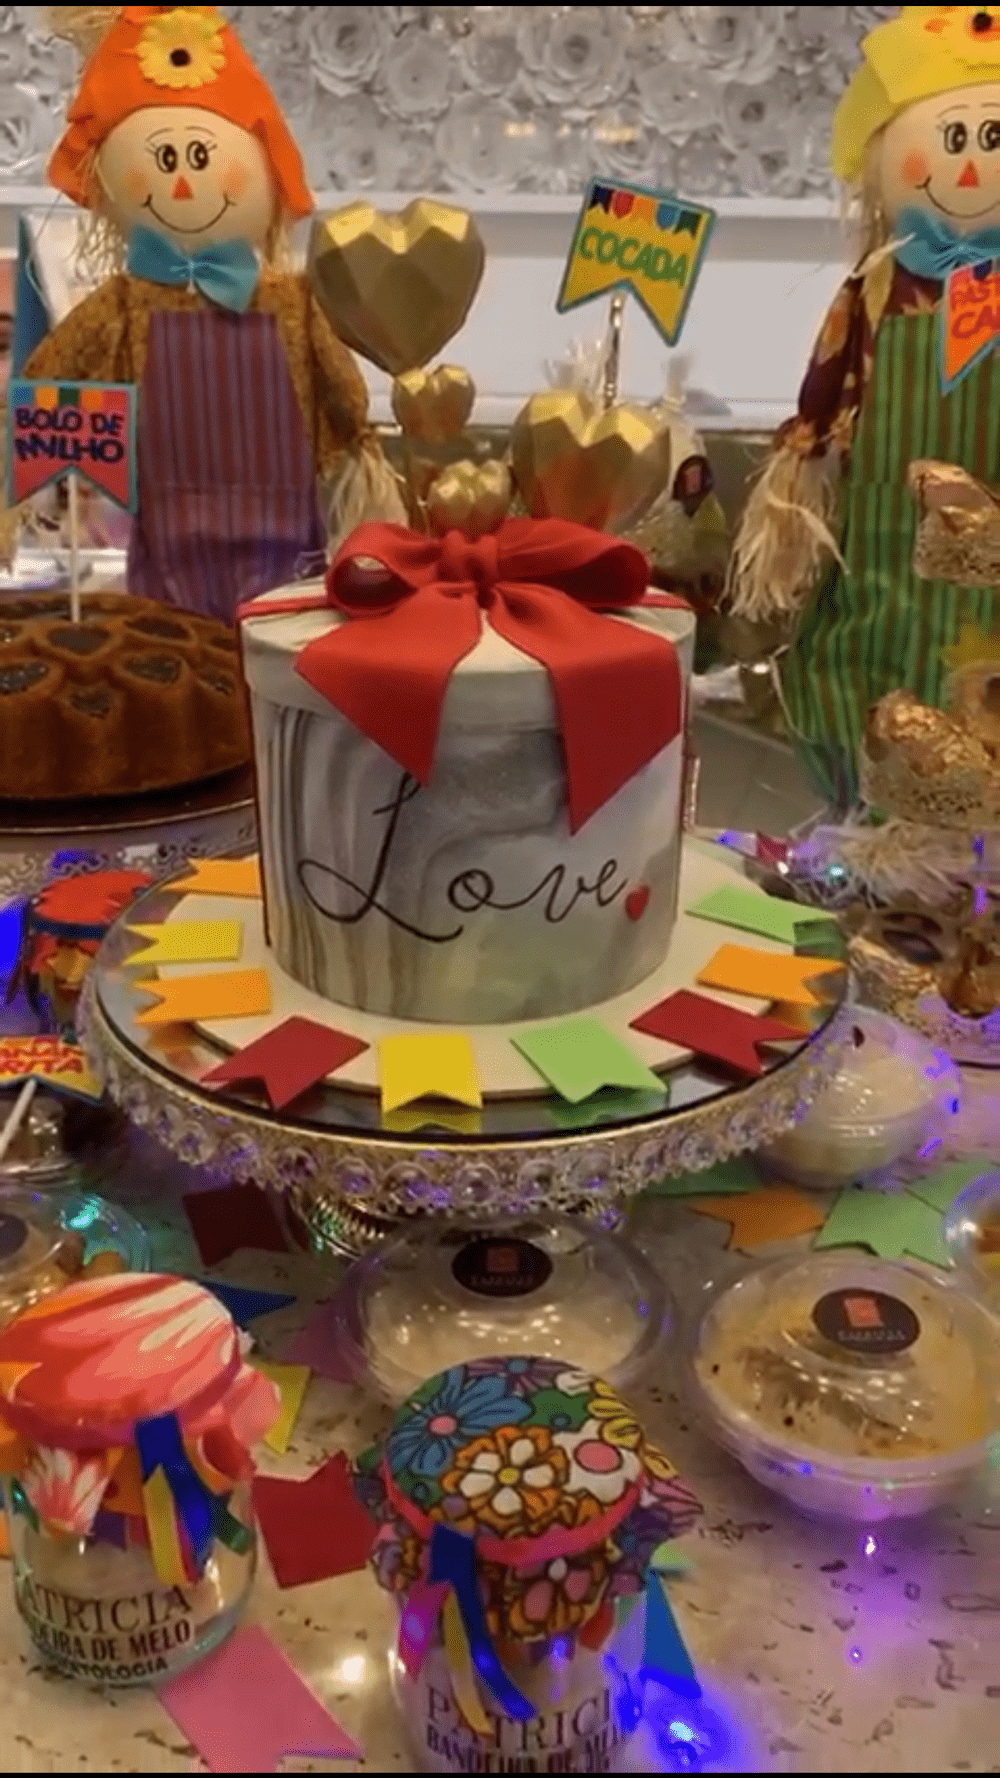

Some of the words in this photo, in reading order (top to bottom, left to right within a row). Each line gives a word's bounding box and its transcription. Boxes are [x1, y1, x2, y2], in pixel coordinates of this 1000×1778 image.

[579, 226, 688, 289] COCADA
[951, 304, 1000, 339] CA
[16, 407, 82, 432] BOLO
[90, 412, 124, 436] DE
[297, 770, 628, 943] Love
[22, 1580, 193, 1634] ATRICIA
[91, 1636, 119, 1661] DE
[129, 1617, 191, 1658] MELO
